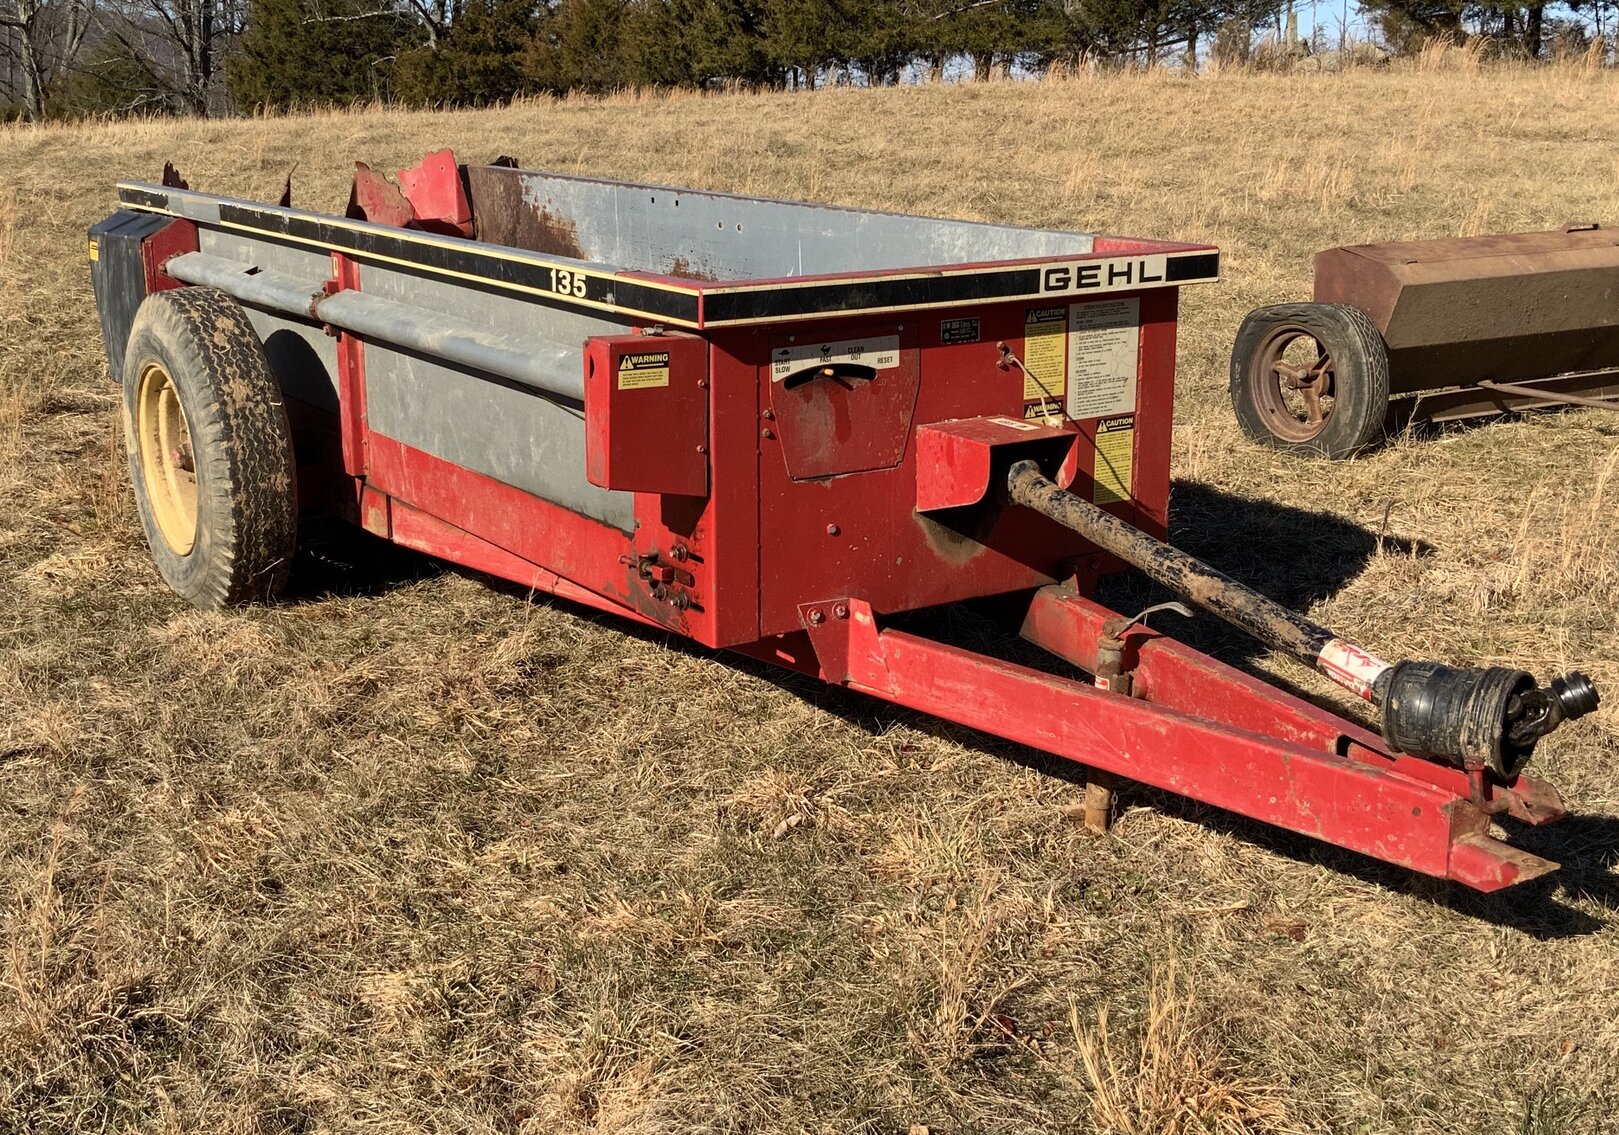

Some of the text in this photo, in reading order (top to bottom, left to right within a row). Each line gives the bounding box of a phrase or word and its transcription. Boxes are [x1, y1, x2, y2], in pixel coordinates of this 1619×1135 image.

[1044, 260, 1162, 291] GEHL
[550, 268, 587, 298] 135
[1036, 307, 1066, 318] CAUTION
[847, 345, 865, 354] CLEAN
[631, 353, 669, 364] WARNING
[774, 358, 791, 366] START
[850, 353, 862, 361] OUT
[877, 356, 893, 364] RESET
[775, 366, 791, 374] SLOW
[1106, 416, 1134, 427] CAUTION
